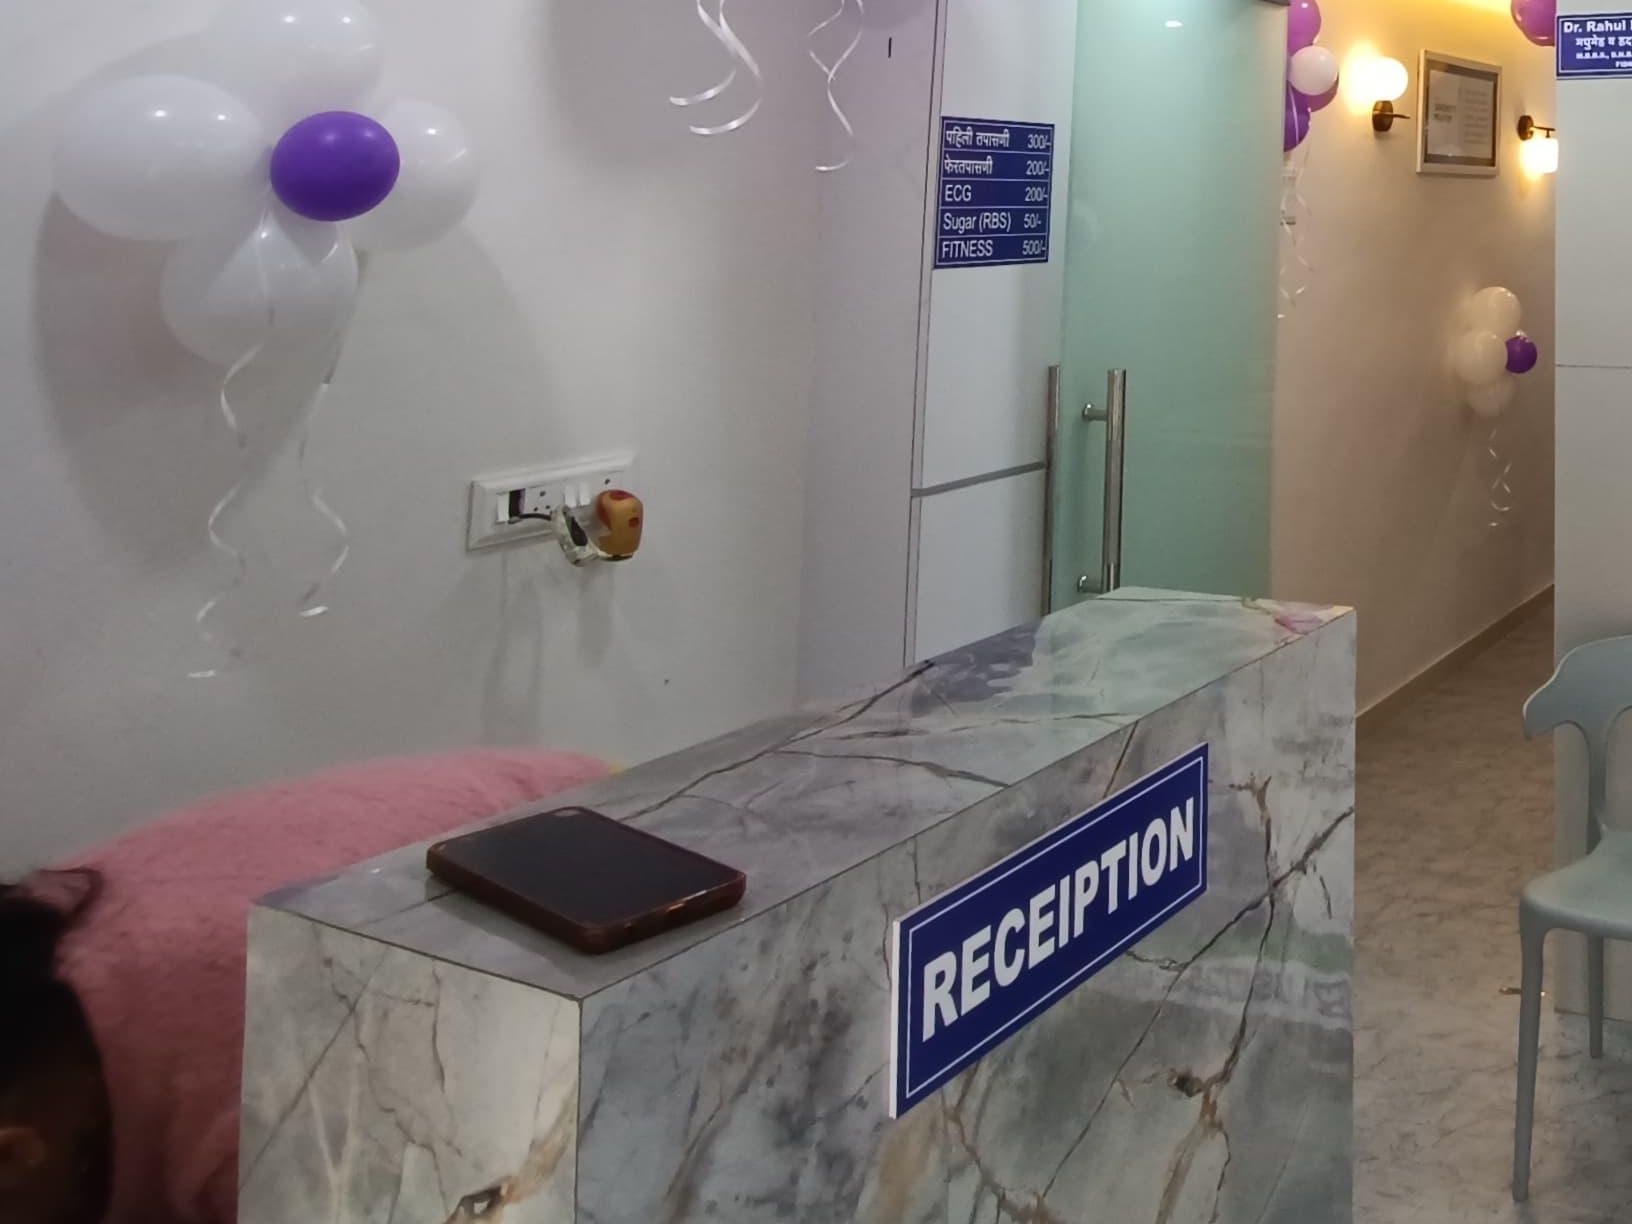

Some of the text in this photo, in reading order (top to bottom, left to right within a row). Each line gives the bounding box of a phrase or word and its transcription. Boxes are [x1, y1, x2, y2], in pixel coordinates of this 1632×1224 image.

[1563, 21, 1582, 33] Dr.
[1586, 19, 1626, 32] Rahul
[1027, 134, 1052, 150] 300/-
[1026, 160, 1051, 176] 200/-
[945, 184, 1049, 202] ECG 200/-
[943, 211, 1042, 234] Sugar (RBS) 50/-
[942, 240, 1047, 259] FITNESS 500/-
[921, 796, 1195, 1043] RECEIPTION
